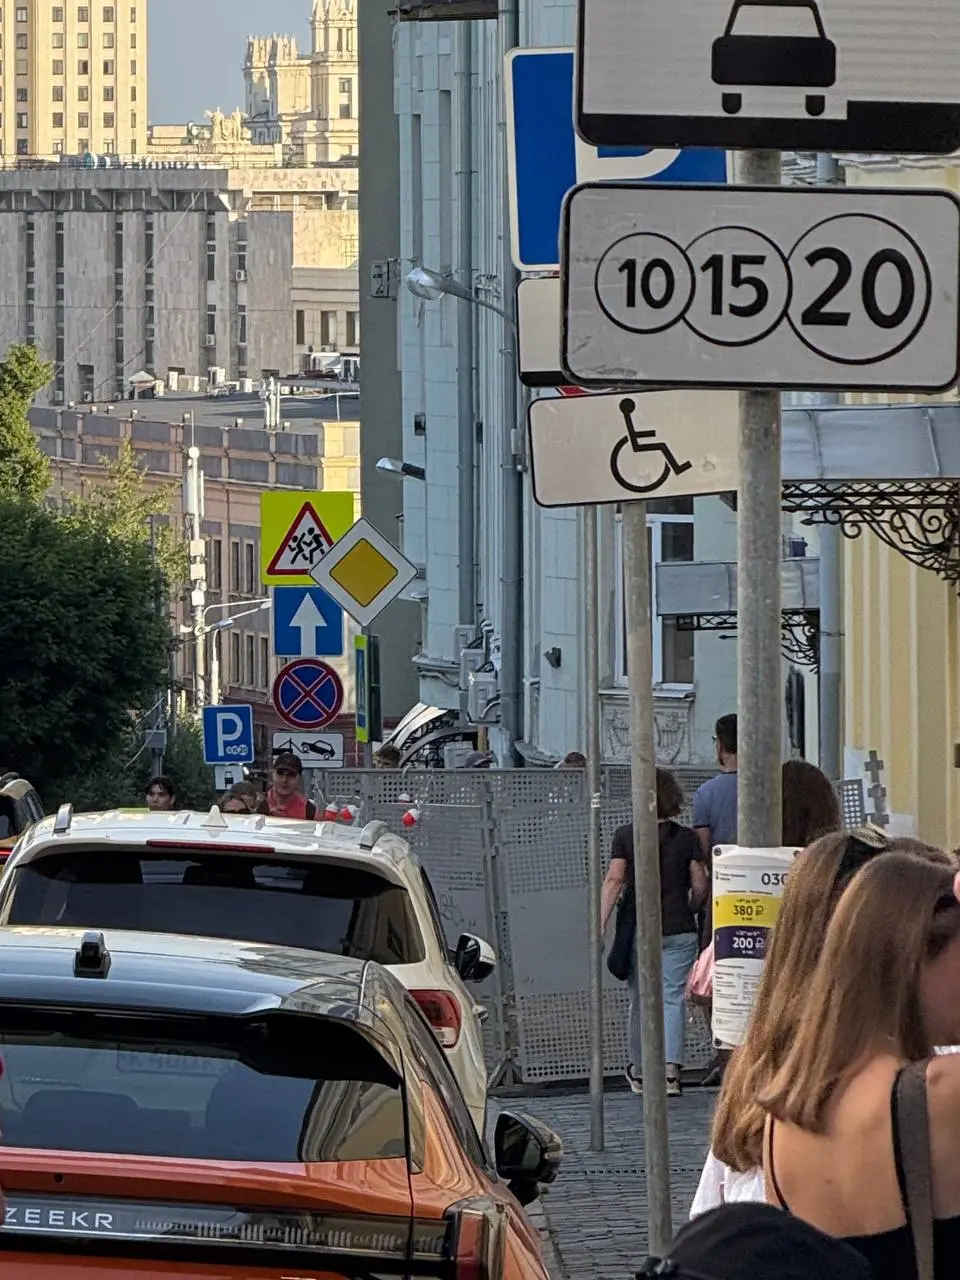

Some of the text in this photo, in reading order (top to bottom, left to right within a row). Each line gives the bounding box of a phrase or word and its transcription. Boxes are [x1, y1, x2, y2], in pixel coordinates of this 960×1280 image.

[618, 247, 915, 329] 10 15 20
[216, 712, 243, 757] P
[733, 905, 753, 916] 380
[732, 937, 754, 949] 200
[4, 1207, 114, 1229] ZEEKR
